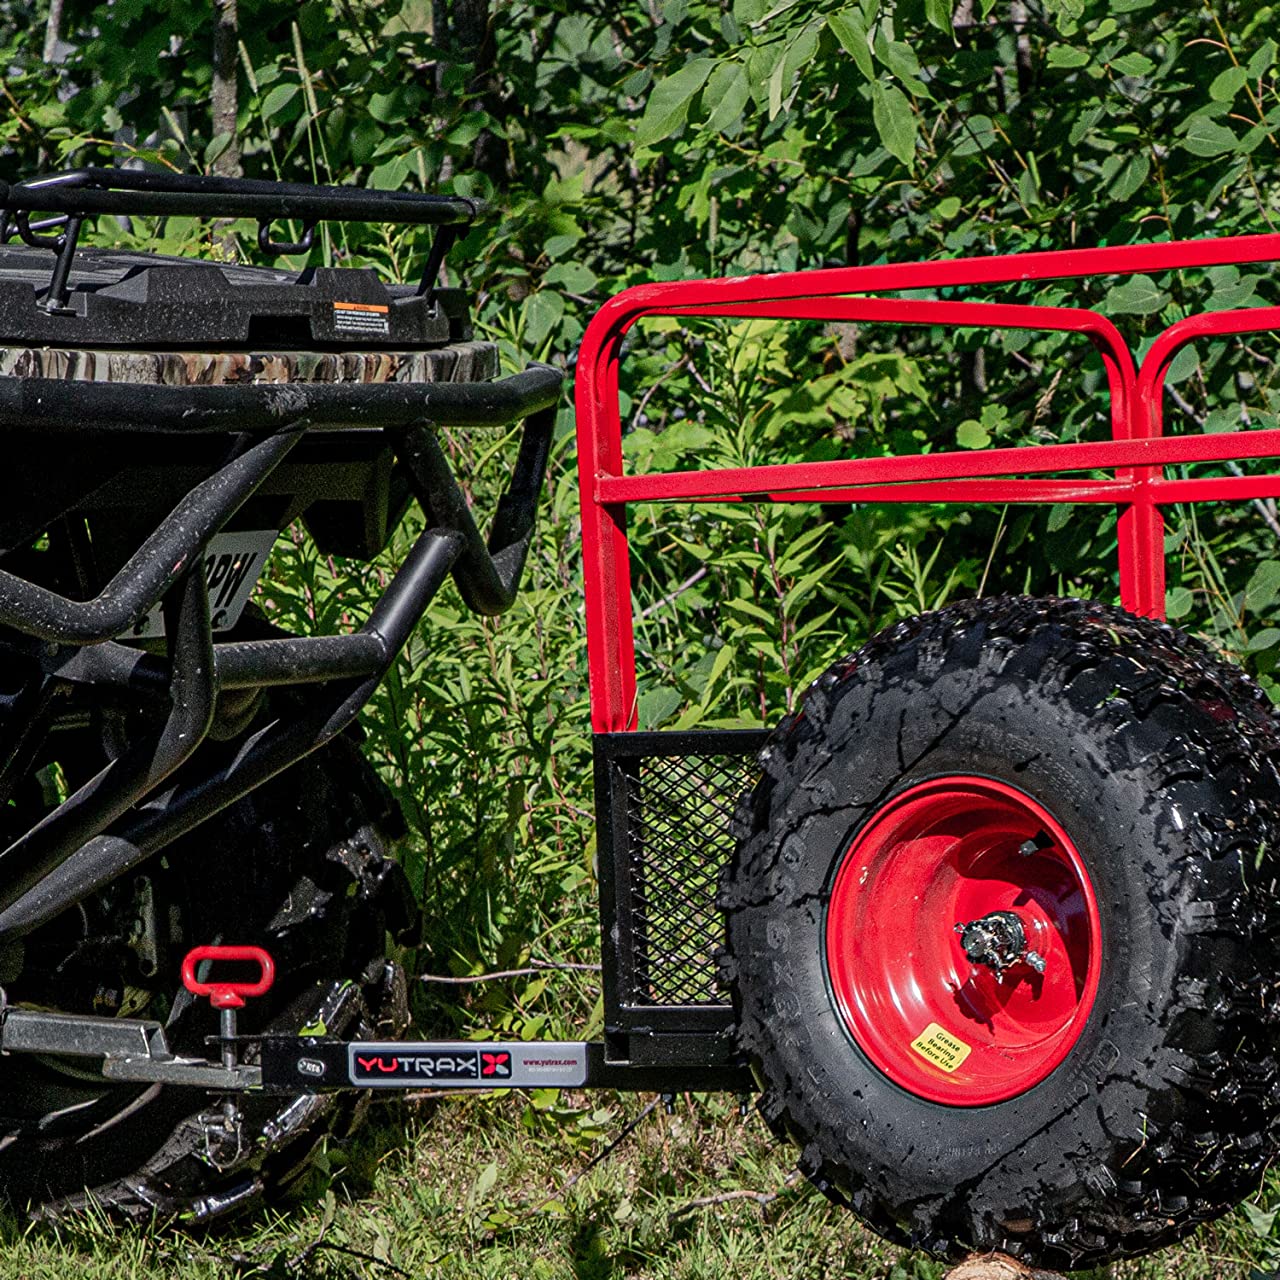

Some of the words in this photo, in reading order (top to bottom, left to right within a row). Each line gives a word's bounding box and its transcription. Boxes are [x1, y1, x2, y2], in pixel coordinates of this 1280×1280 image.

[927, 1038, 956, 1061] Bearing
[936, 1032, 961, 1052] Grease
[522, 1058, 577, 1067] www.yutrax.com
[916, 1041, 940, 1060] Before
[940, 1057, 954, 1069] Use
[357, 1056, 477, 1077] YUTRAX
